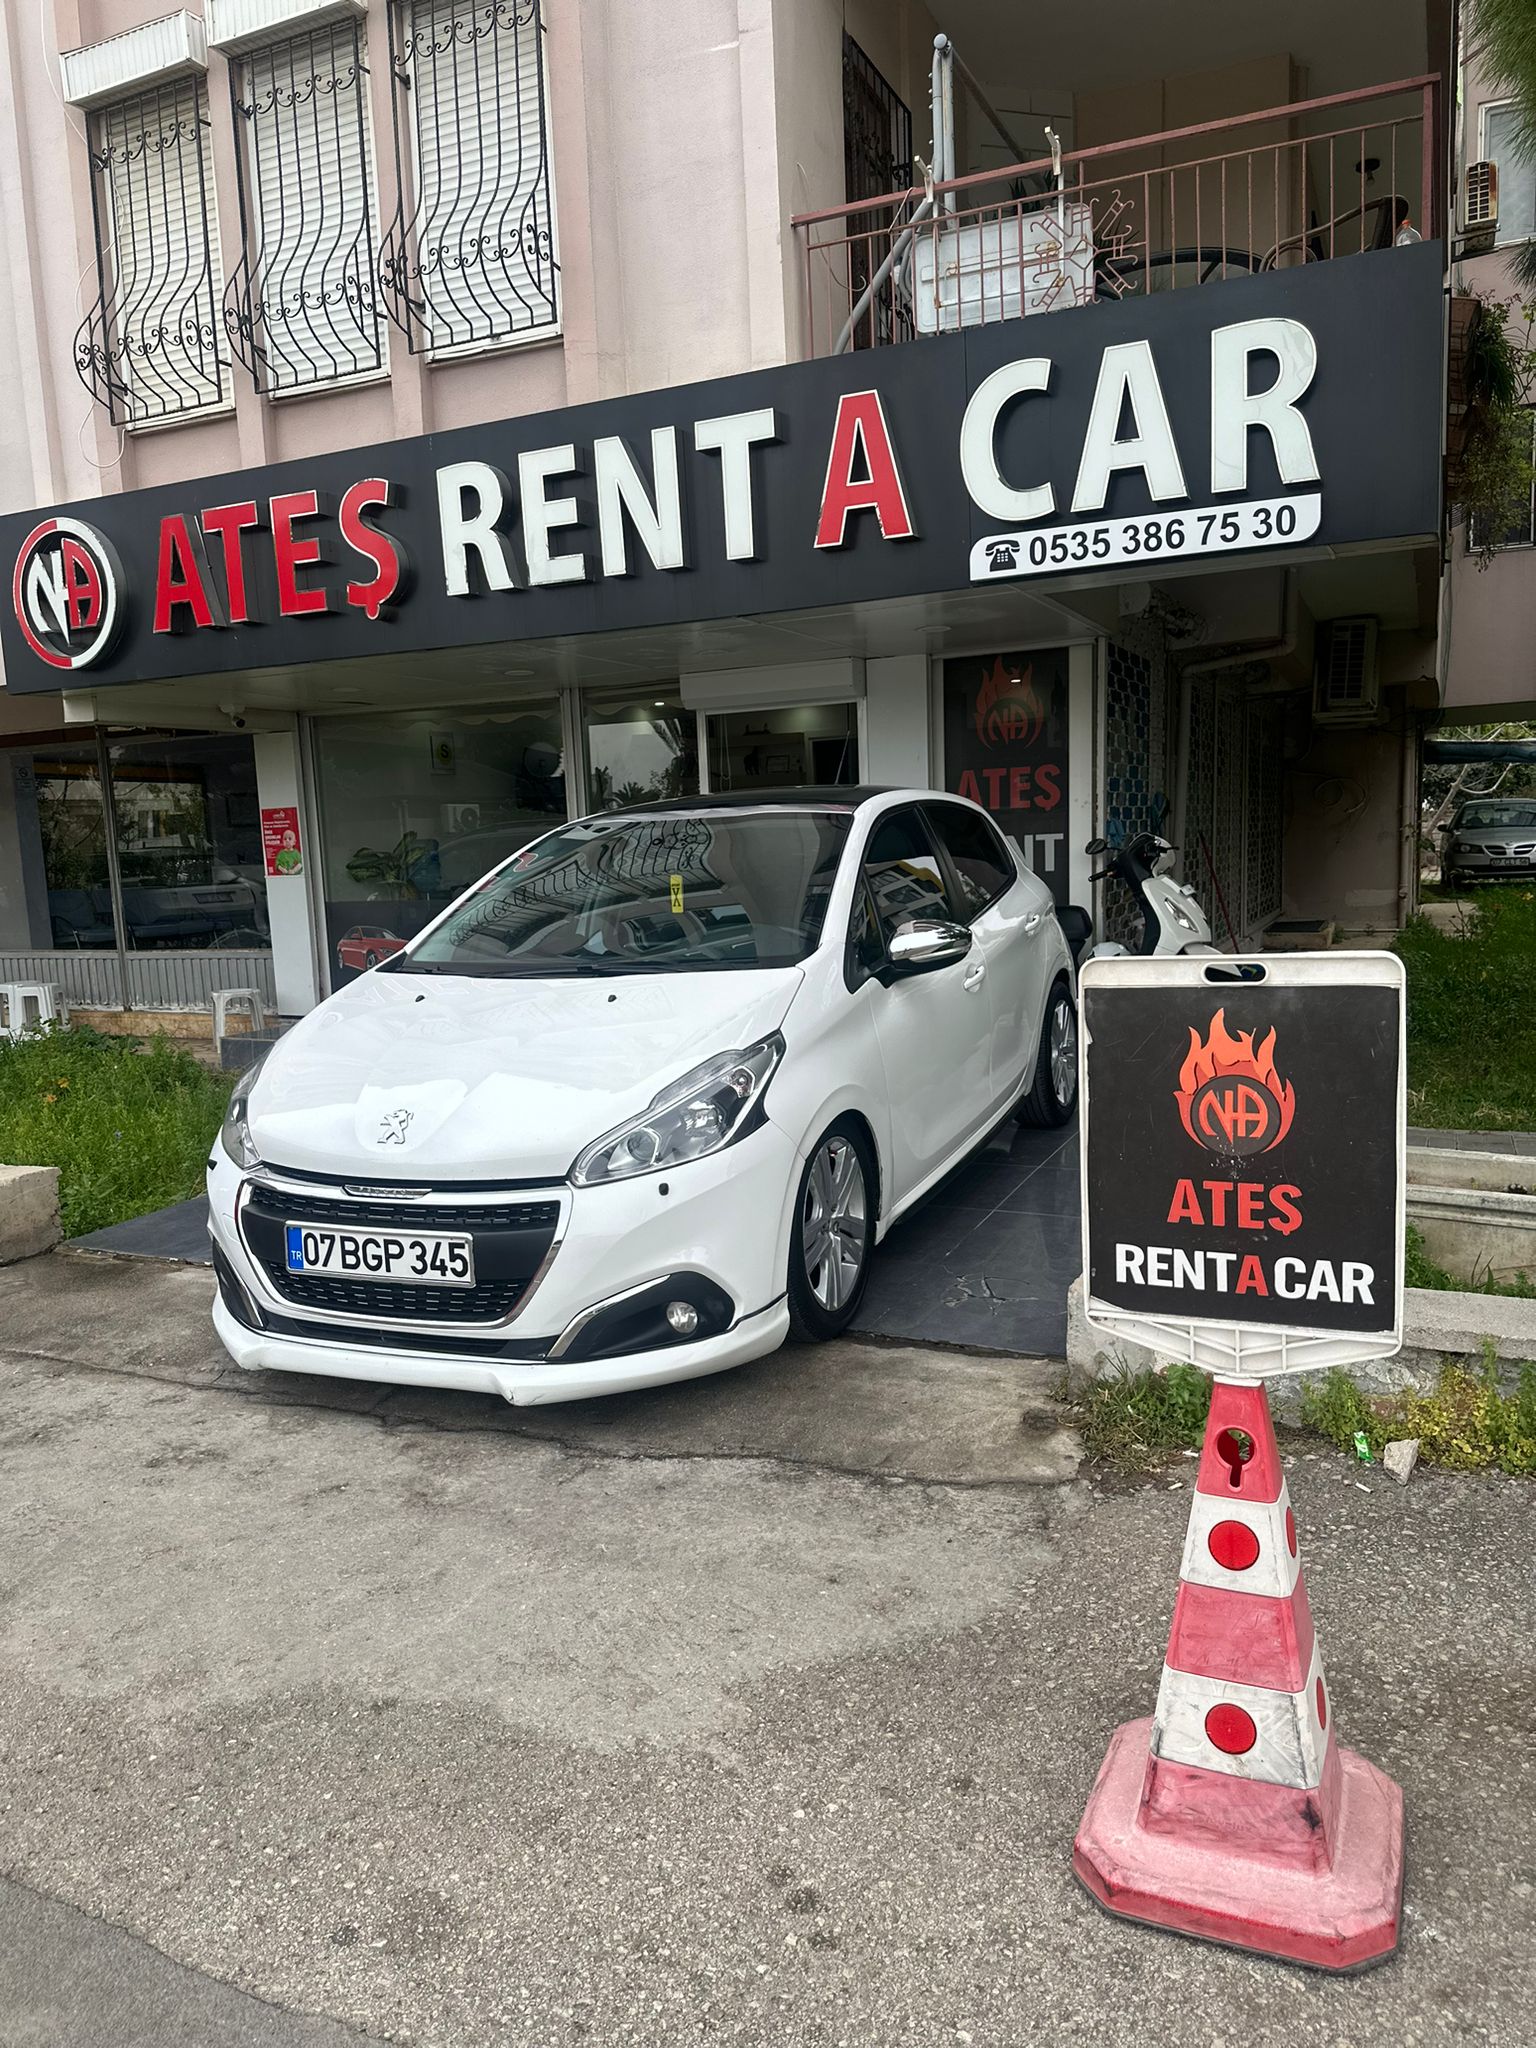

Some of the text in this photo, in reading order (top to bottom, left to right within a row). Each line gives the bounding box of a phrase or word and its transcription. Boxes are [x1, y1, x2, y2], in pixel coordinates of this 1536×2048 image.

[152, 317, 1321, 634] ATEŞ RENT A CAR
[1029, 503, 1298, 567] 0535 386 75 30
[957, 763, 1062, 812] ATEŞ
[1005, 832, 1065, 873] NT
[1166, 1178, 1304, 1236] ATEŞ
[291, 1232, 469, 1278] TR 07 BGP 345
